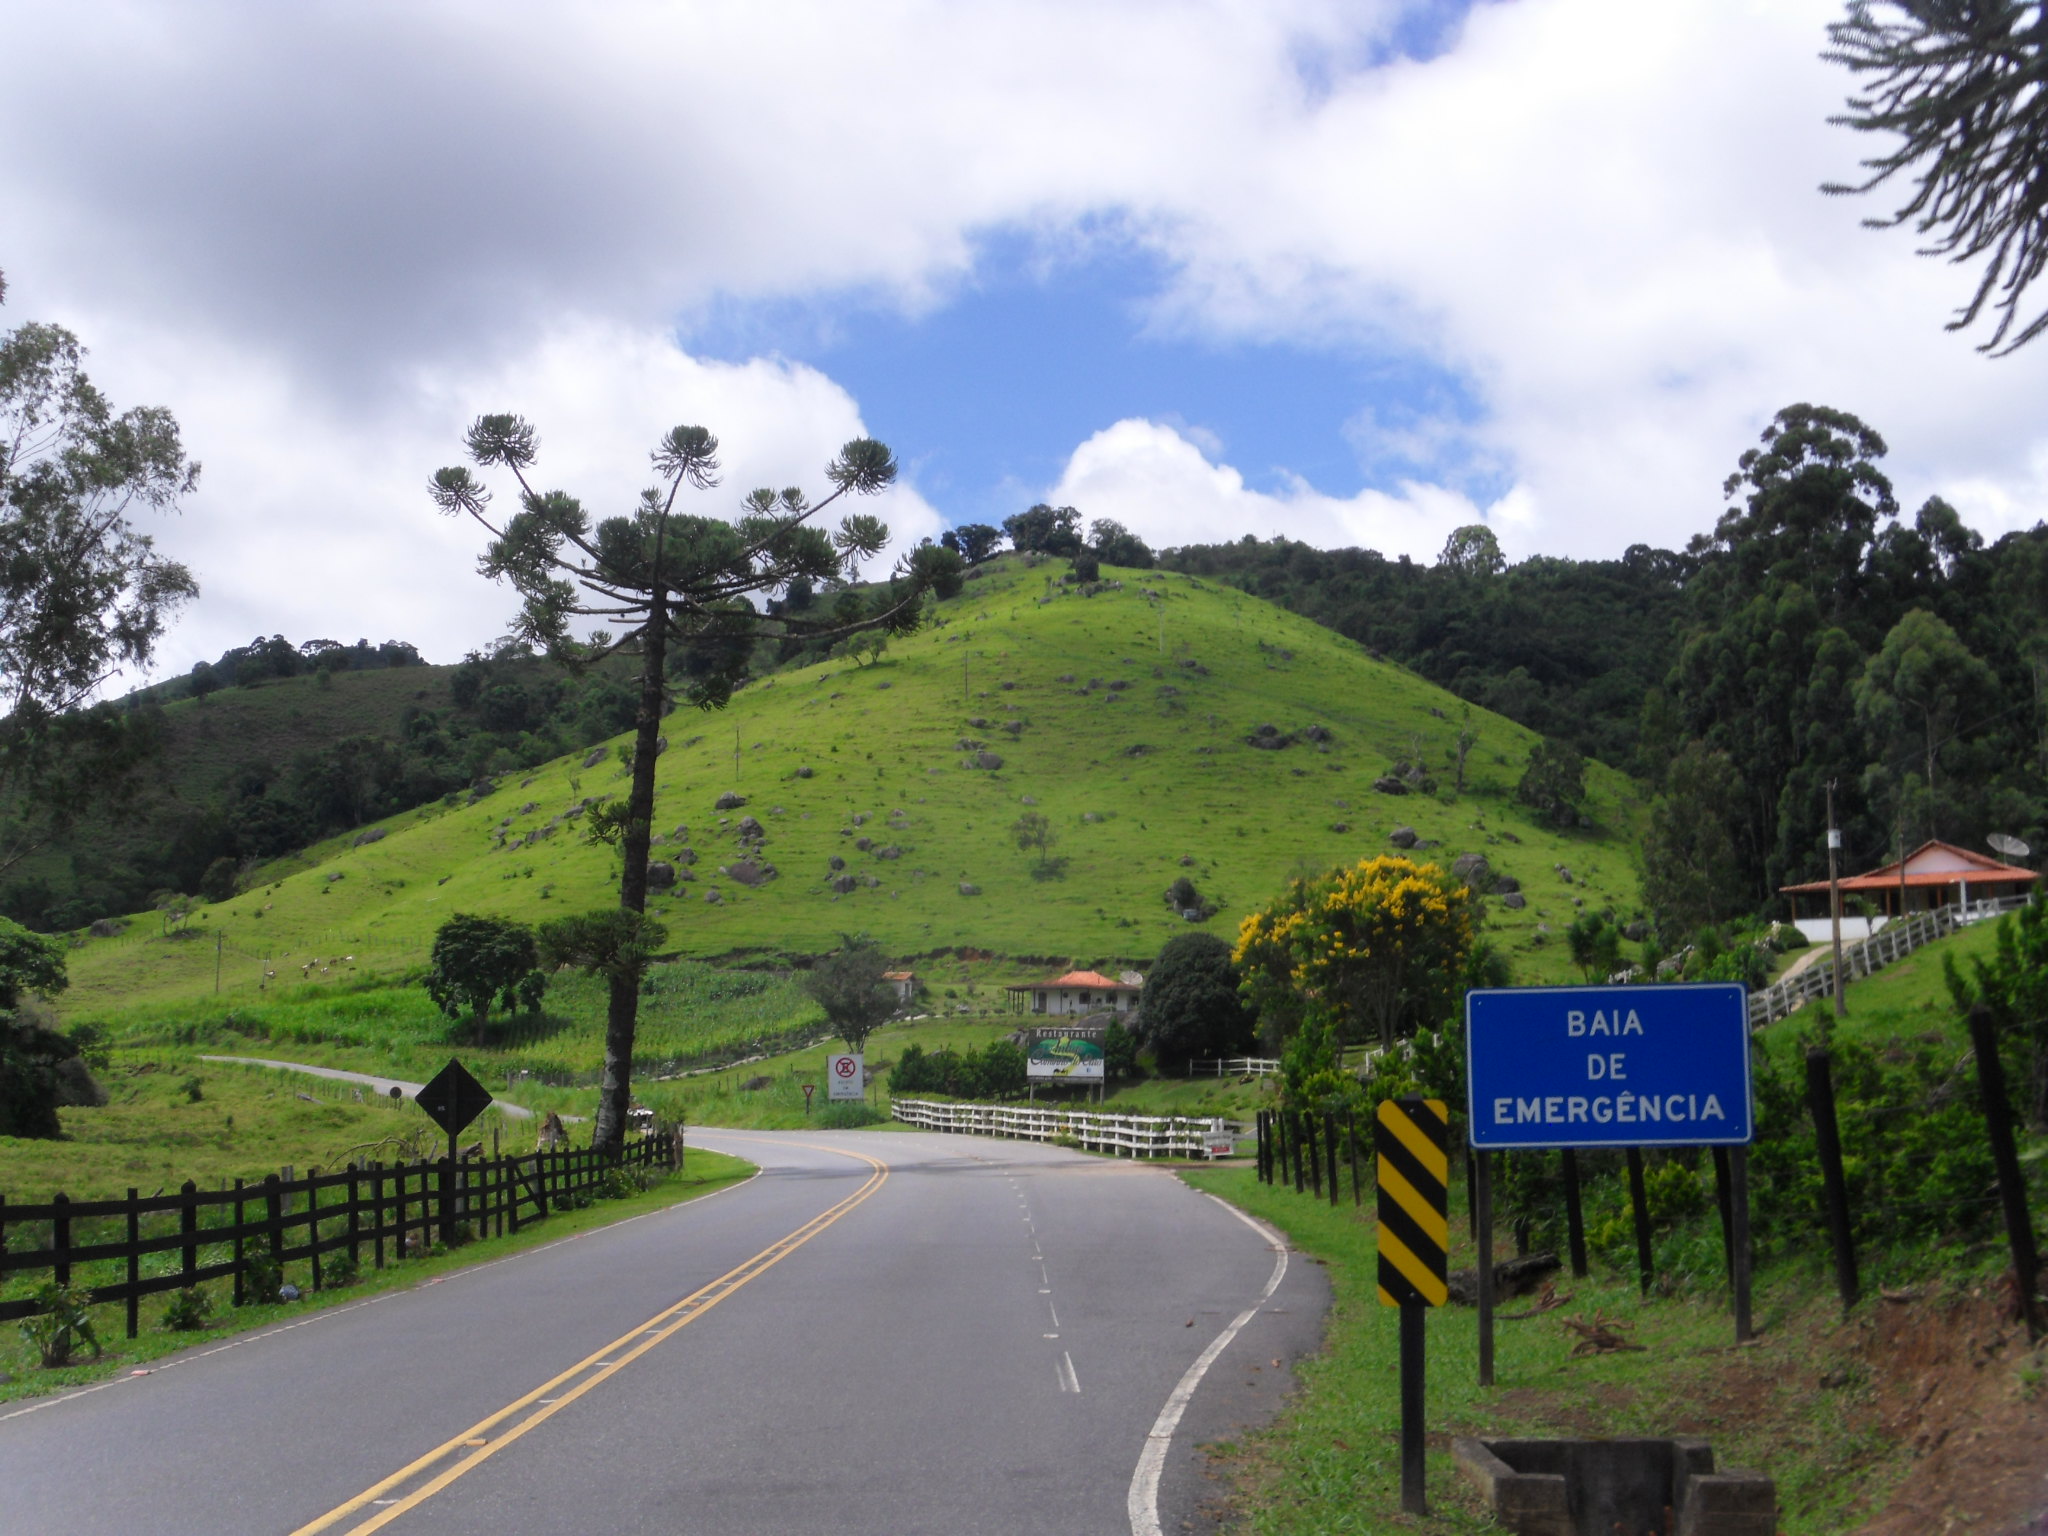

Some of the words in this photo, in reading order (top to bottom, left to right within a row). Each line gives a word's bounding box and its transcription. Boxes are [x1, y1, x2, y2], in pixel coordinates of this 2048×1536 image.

[1036, 1029, 1097, 1039] Restaurante
[1567, 1009, 1644, 1037] BAIA
[1587, 1053, 1627, 1080] DE
[1493, 1090, 1725, 1124] EMERGÊNCIA
